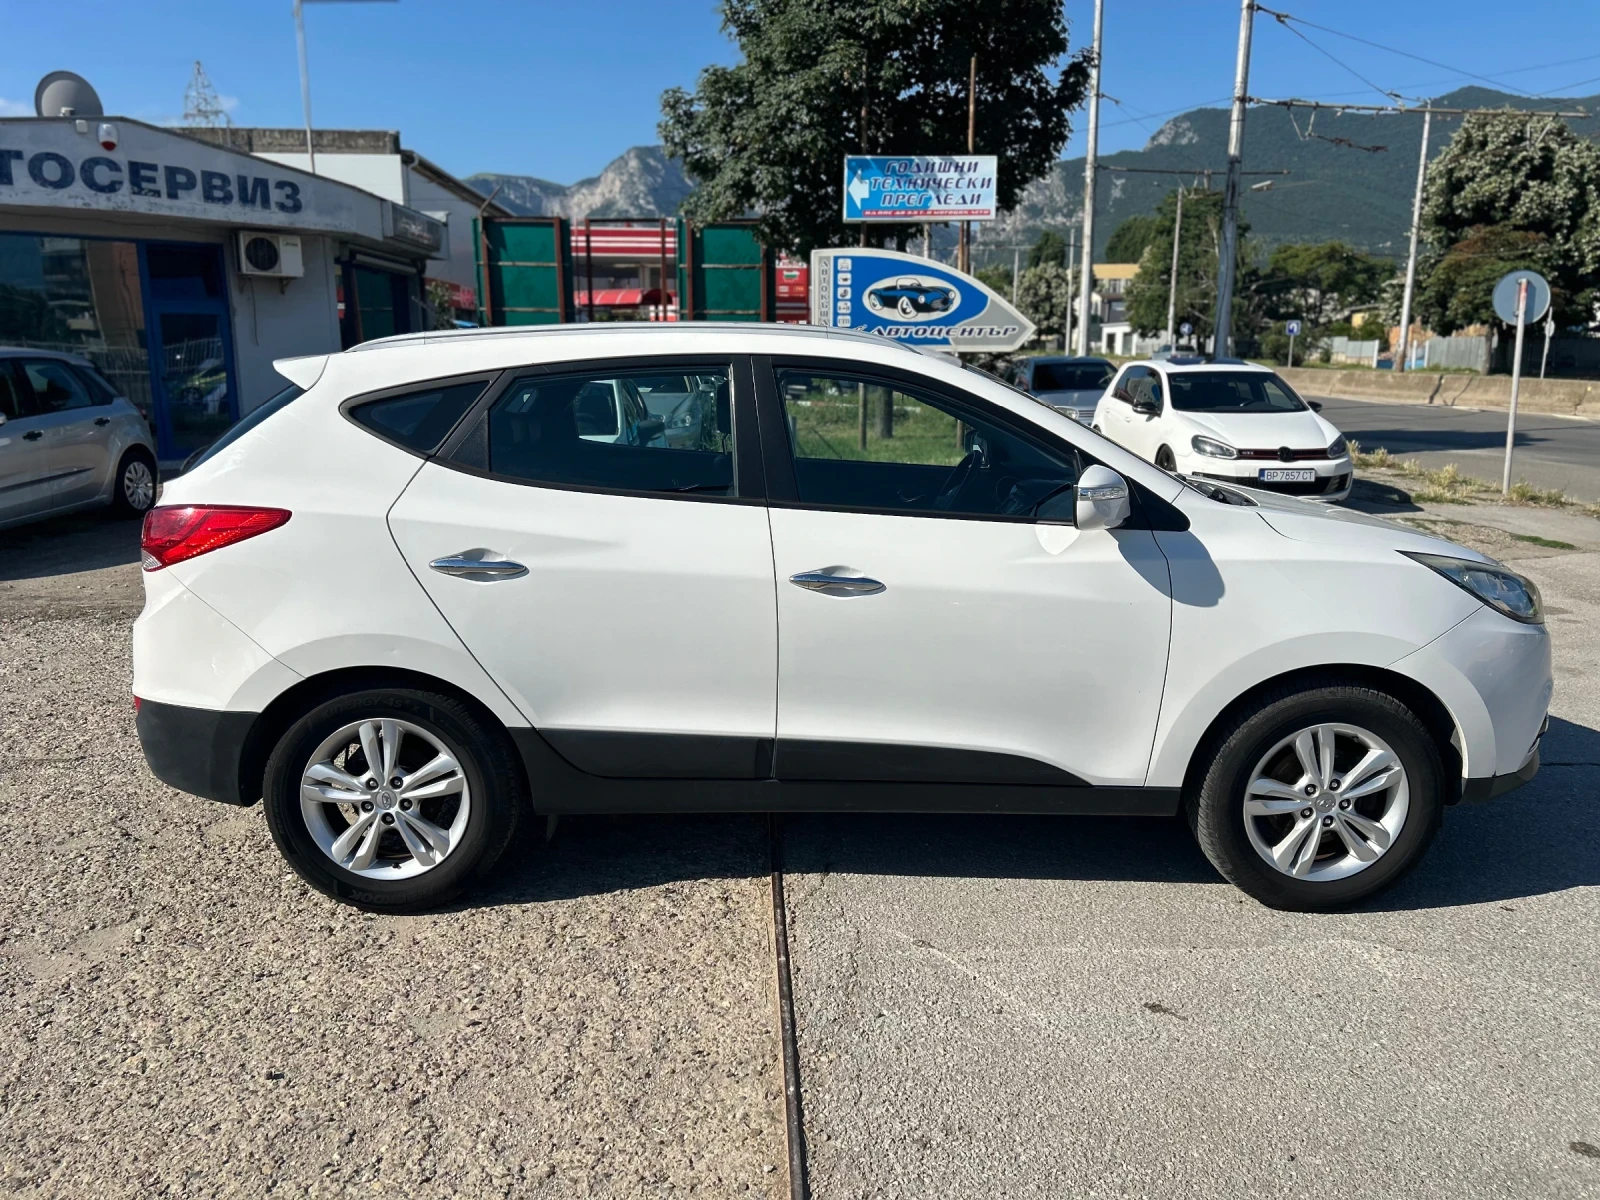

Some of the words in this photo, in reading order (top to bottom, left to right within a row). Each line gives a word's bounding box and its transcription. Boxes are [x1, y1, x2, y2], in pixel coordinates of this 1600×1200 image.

[885, 161, 979, 175] ГОДИШНИ
[0, 149, 304, 214] ТОСЕРВИЗ
[871, 177, 992, 190] ТЕХНИЧЕСКИ
[880, 193, 982, 206] ПРЕГЛЕДИ
[870, 326, 1018, 339] АВТОЦЕНТЪР
[1280, 471, 1301, 481] 7857
